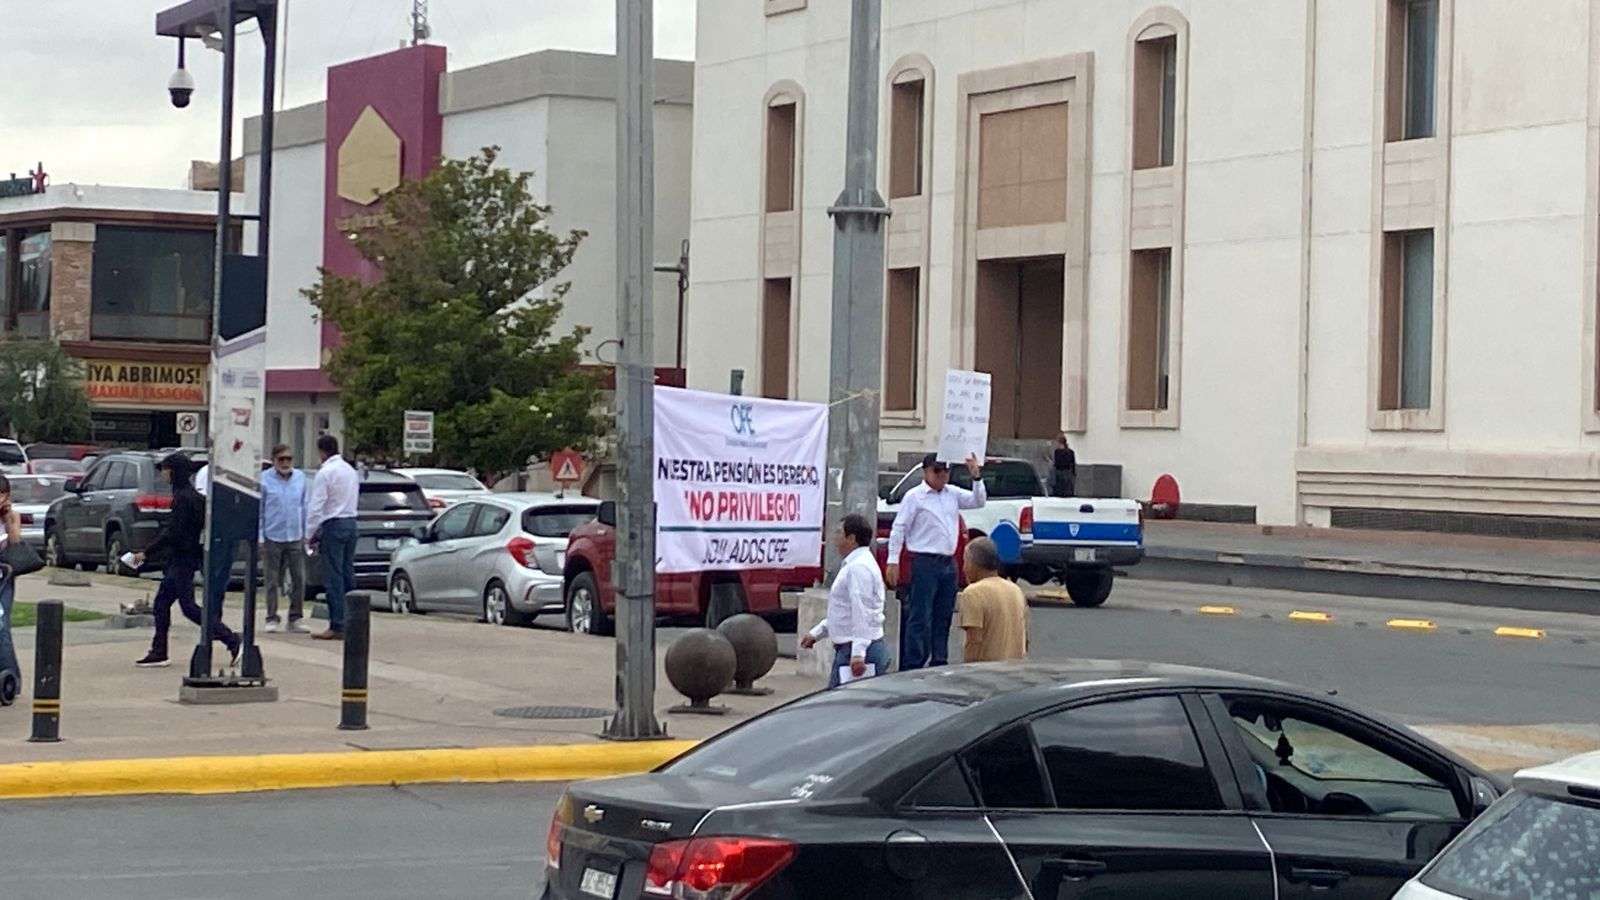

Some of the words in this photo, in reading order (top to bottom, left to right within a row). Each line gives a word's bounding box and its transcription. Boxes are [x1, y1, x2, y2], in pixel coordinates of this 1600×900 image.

[118, 366, 200, 385] ABRIMOS!
[731, 403, 755, 434] CFE
[657, 457, 713, 481] NESTRA
[713, 457, 762, 484] PENSIÓN
[763, 463, 776, 484] ES
[718, 491, 800, 522] PRIVILEGIO!
[767, 538, 789, 563] CFE
